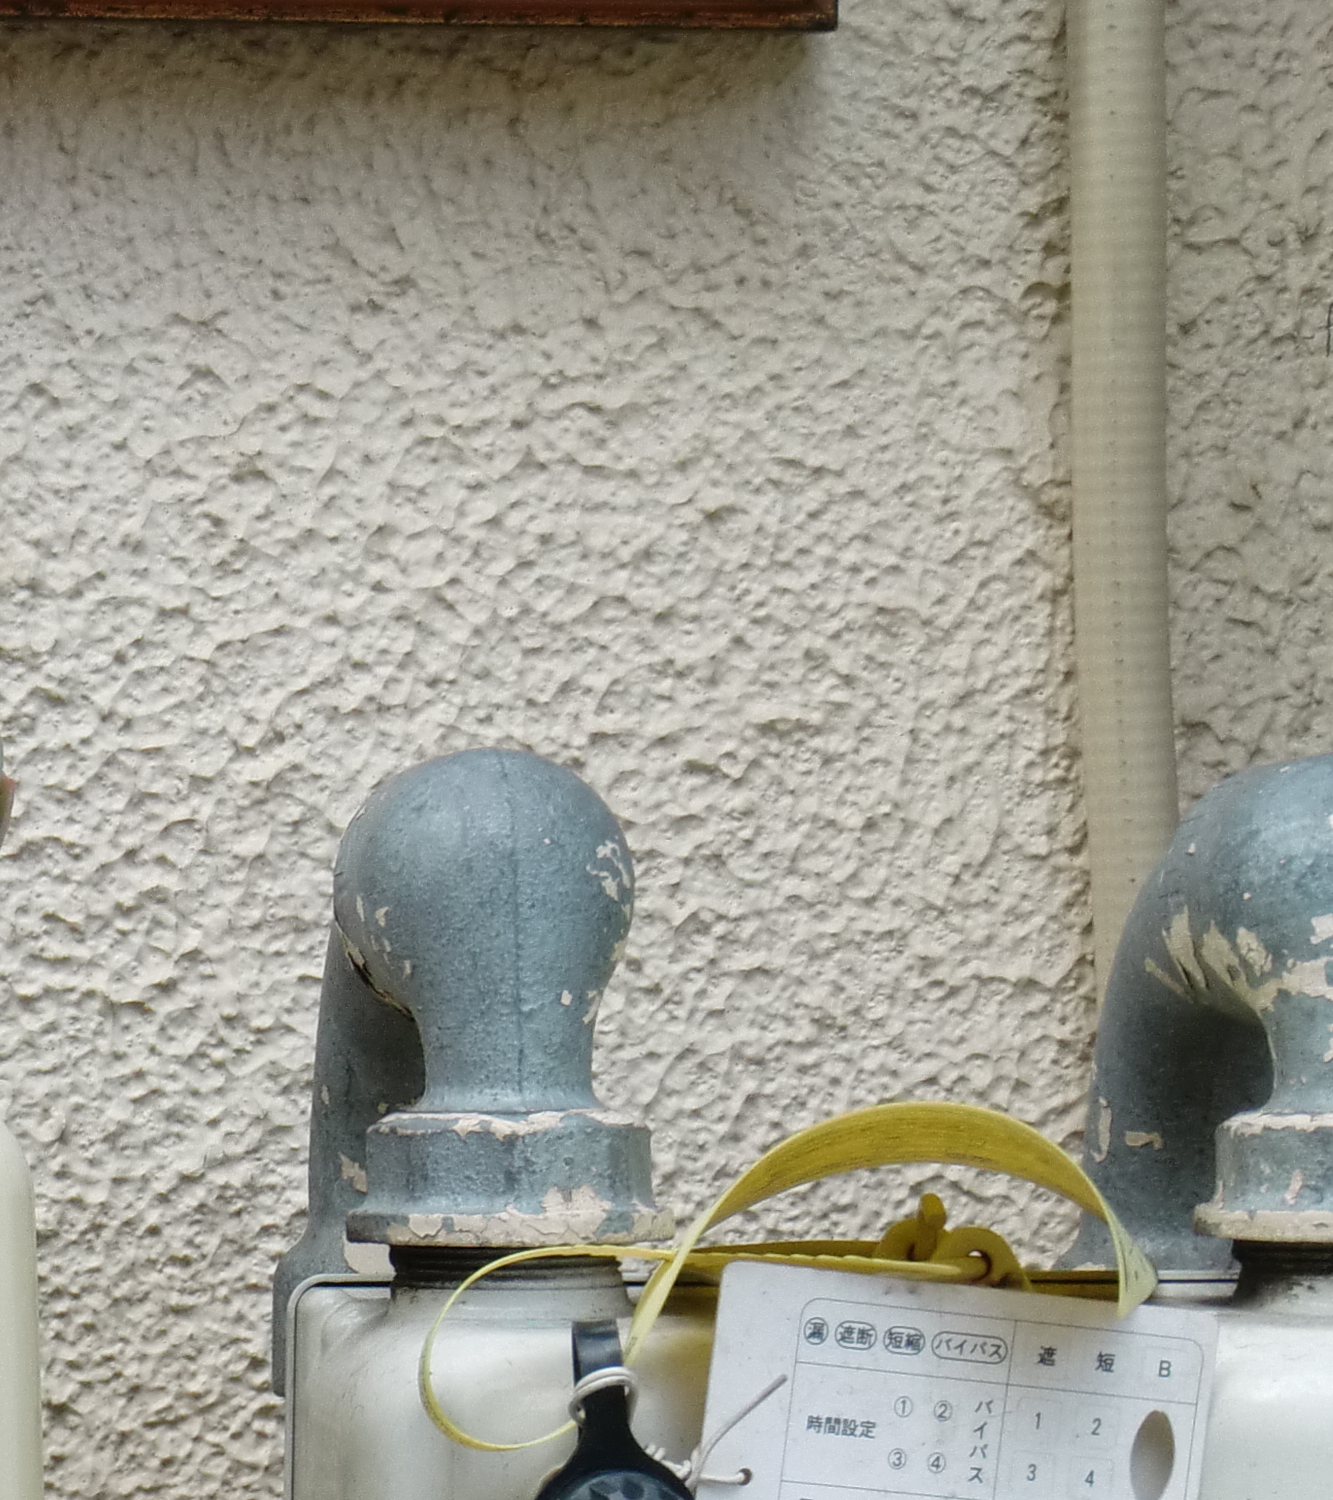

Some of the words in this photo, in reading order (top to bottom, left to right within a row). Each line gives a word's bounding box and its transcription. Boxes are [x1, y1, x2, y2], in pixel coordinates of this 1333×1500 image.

[838, 1326, 874, 1346] 遮断
[935, 1337, 1003, 1360] バイパス
[1095, 1352, 1116, 1373] 短
[1157, 1360, 1172, 1377] B
[805, 1415, 877, 1439] 時間設定
[1034, 1411, 1042, 1430] 1
[1090, 1417, 1102, 1436] 2
[1026, 1463, 1038, 1482] 3
[1084, 1469, 1095, 1488] 4
